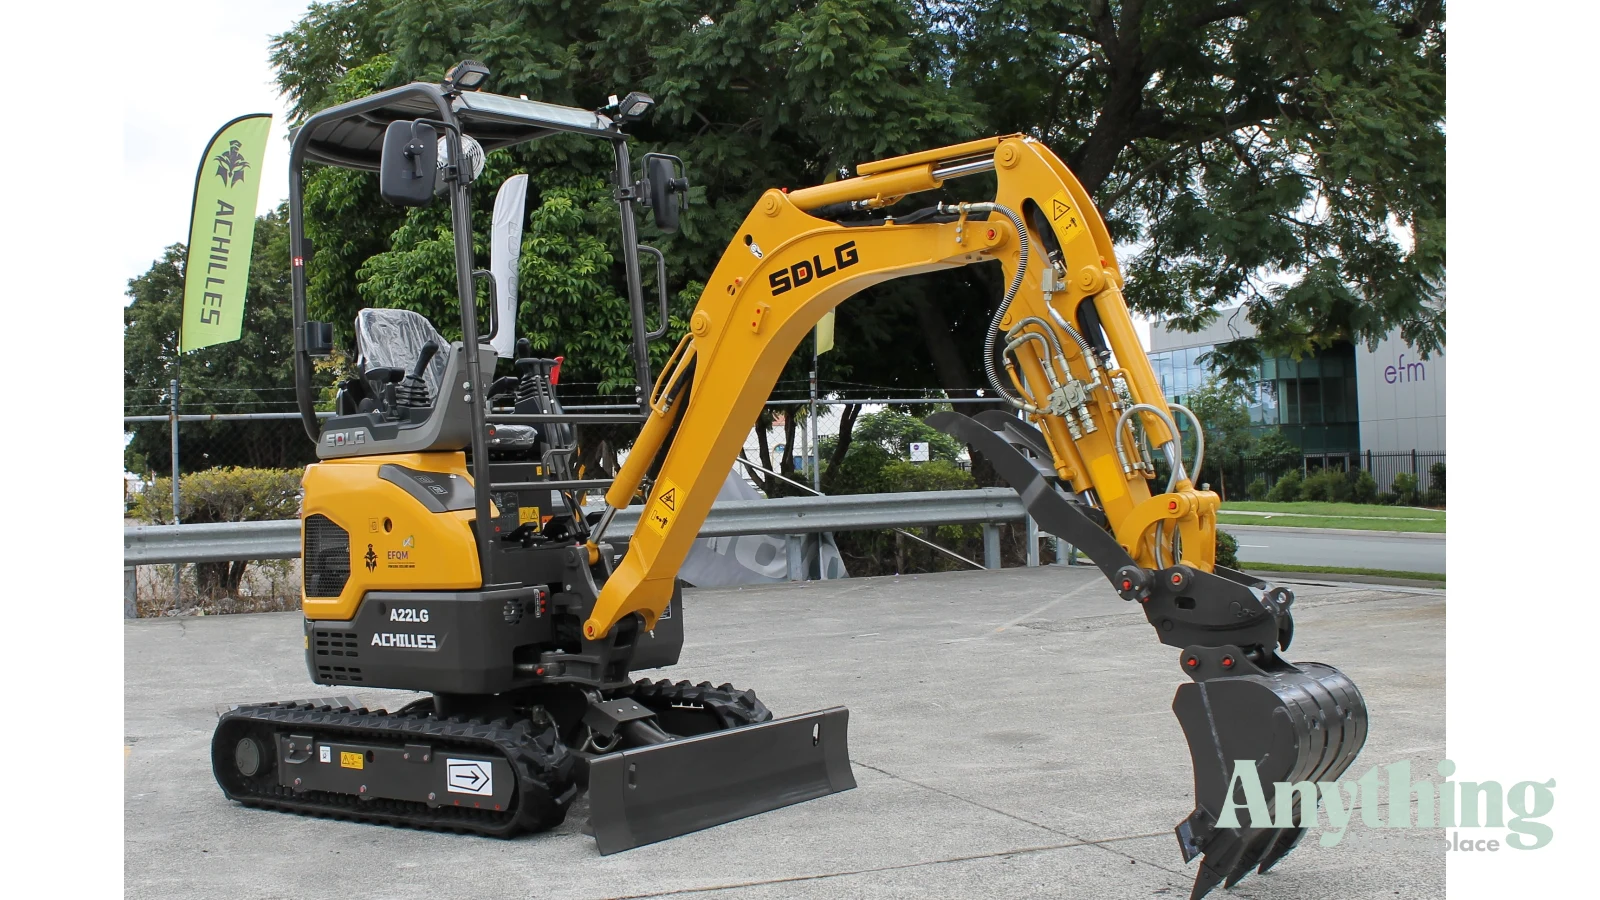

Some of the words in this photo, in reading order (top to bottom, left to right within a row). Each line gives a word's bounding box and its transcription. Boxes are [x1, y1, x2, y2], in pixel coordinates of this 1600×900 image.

[200, 199, 235, 325] ACHILLES
[769, 240, 859, 297] SDLG
[1384, 354, 1425, 384] efm
[326, 431, 365, 447] SDLG
[387, 551, 408, 560] EFQM
[390, 608, 429, 622] A22LG
[371, 633, 437, 649] ACHILLES
